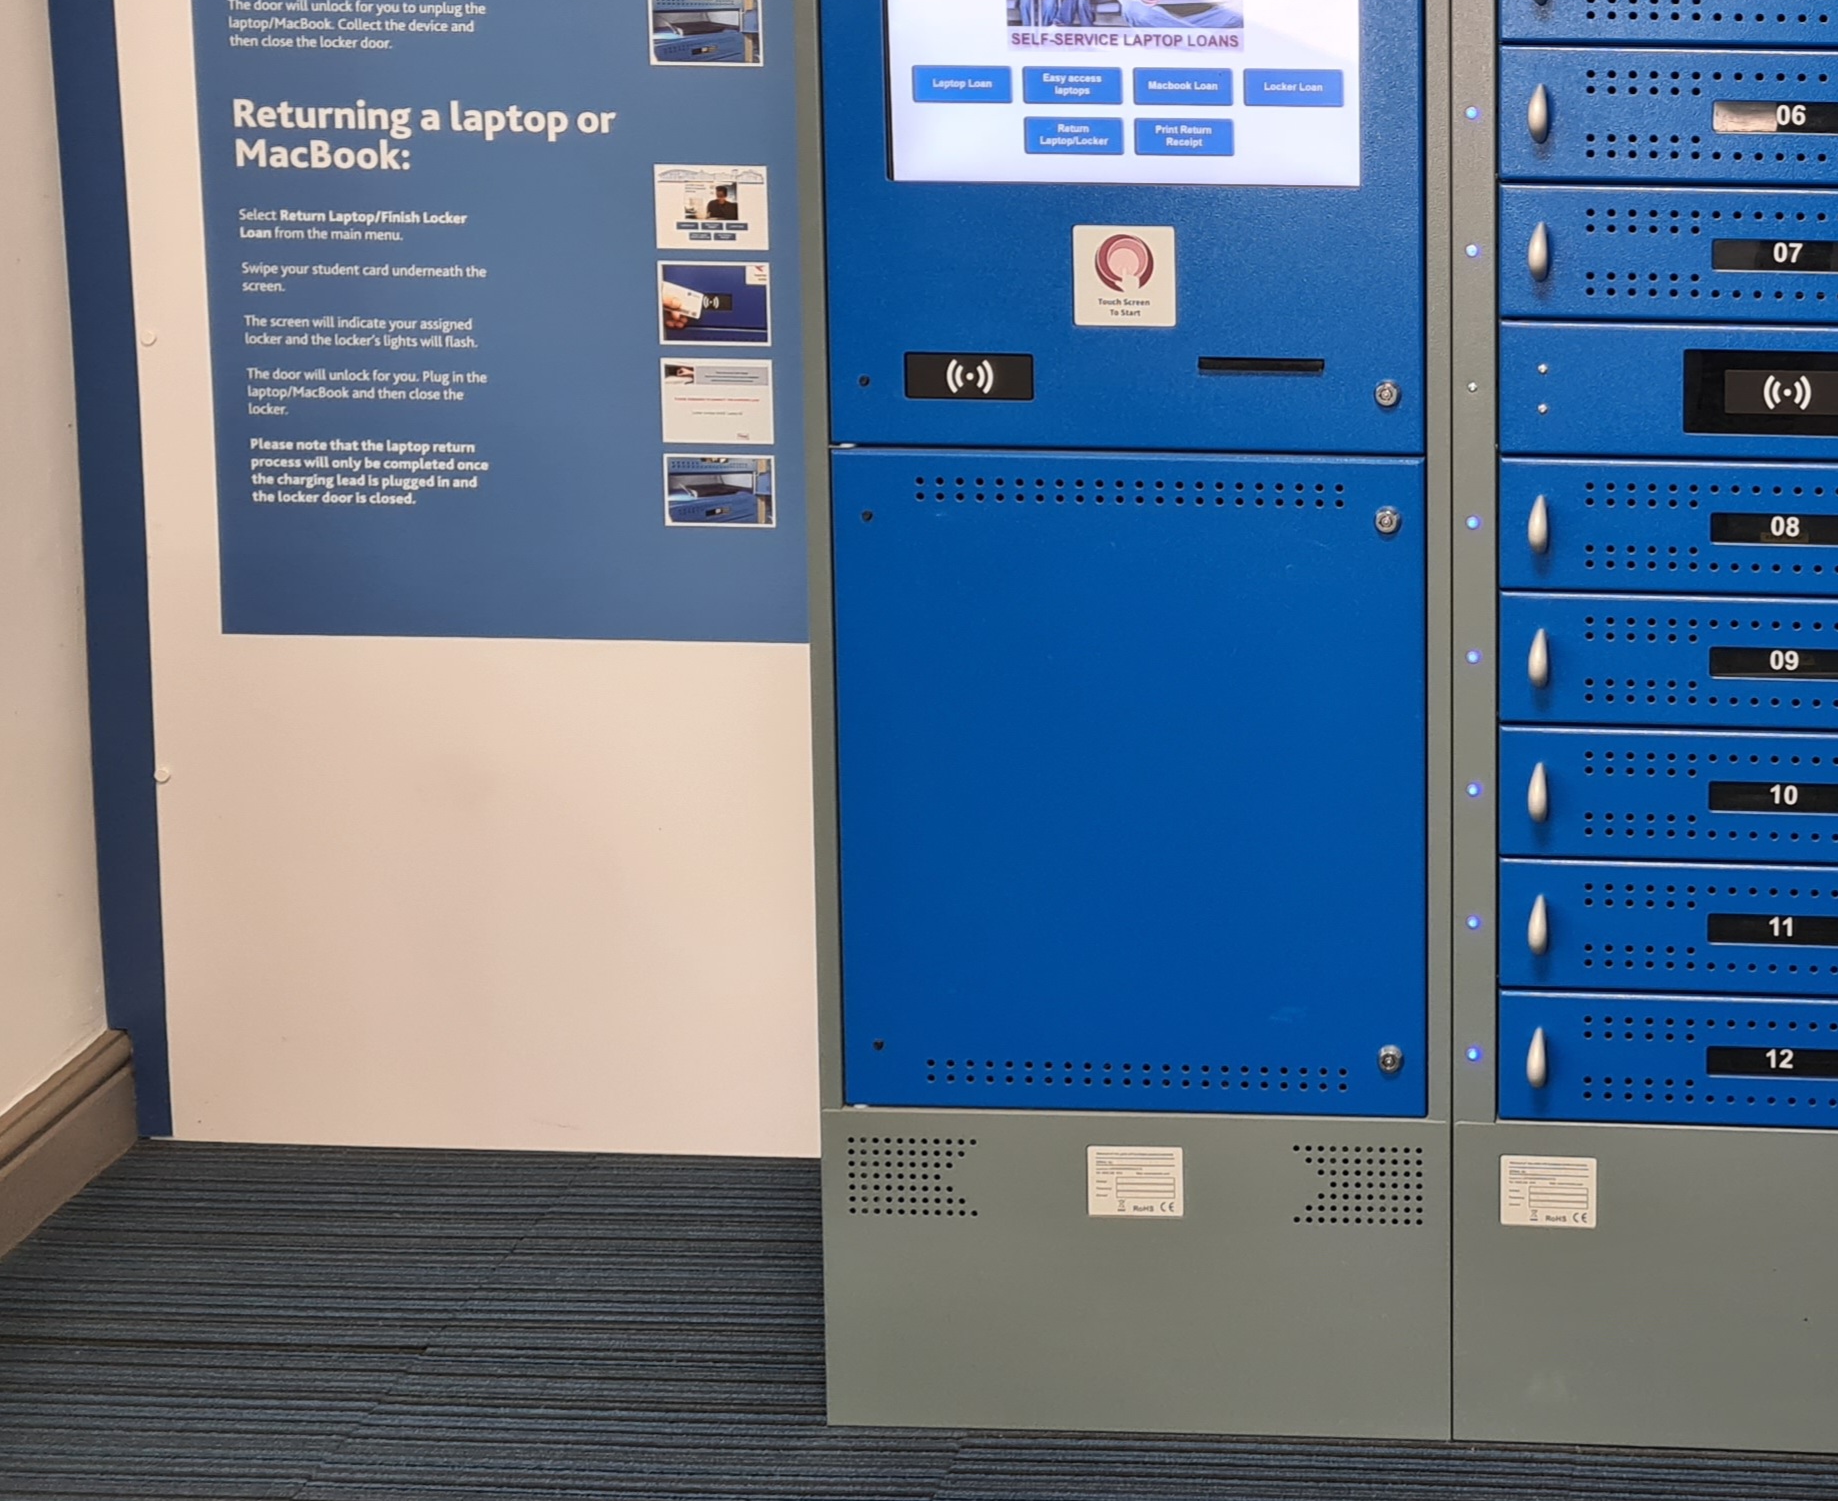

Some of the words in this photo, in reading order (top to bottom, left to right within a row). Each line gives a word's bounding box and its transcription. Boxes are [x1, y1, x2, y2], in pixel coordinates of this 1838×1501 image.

[1011, 33, 1118, 47] SELF-SERVICE
[1123, 34, 1183, 48] LAPTOP
[1188, 35, 1238, 48] LOANS
[932, 79, 965, 90] Laptop
[967, 79, 992, 89] Loan
[1042, 73, 1066, 84] Easy
[1068, 75, 1101, 84] access
[1148, 81, 1191, 91] Macbook
[1194, 82, 1218, 91] Loan
[1055, 86, 1090, 97] laptops
[1264, 82, 1296, 92] Locker
[1298, 83, 1323, 92] Loan
[234, 99, 412, 140] Returning
[421, 109, 440, 130] a
[451, 101, 568, 141] laptop
[577, 112, 616, 133] or
[1776, 104, 1806, 125] 06
[1058, 124, 1089, 133] Return
[1155, 125, 1179, 134] Print
[1182, 126, 1212, 135] Return
[1040, 136, 1108, 147] Laptop/Locker
[1166, 137, 1202, 148] Receipt
[236, 139, 410, 170] MacBook:
[1774, 243, 1802, 262] 07
[251, 438, 295, 450] Please
[297, 440, 327, 450] note
[328, 439, 360, 451] that
[359, 440, 383, 451] the
[387, 440, 431, 455] laptop
[431, 442, 475, 452] return
[251, 459, 303, 470] process
[304, 457, 330, 468] will
[330, 458, 361, 471] only
[365, 458, 380, 469] be
[384, 459, 456, 472] completed
[457, 462, 488, 470] once
[252, 474, 276, 484] the
[277, 474, 336, 489] charging
[337, 475, 366, 486] lead
[366, 475, 380, 488] is
[380, 476, 435, 490] plugged
[437, 476, 451, 487] in
[453, 477, 477, 487] and
[252, 492, 276, 502] the
[276, 492, 321, 502] locker
[322, 493, 354, 503] door
[354, 493, 368, 503] is
[369, 493, 416, 504] closed.
[1771, 516, 1799, 536] 08
[1771, 651, 1798, 670] 09
[1771, 785, 1797, 804] 10
[1770, 917, 1792, 936] 11
[1767, 1049, 1793, 1068] 12
